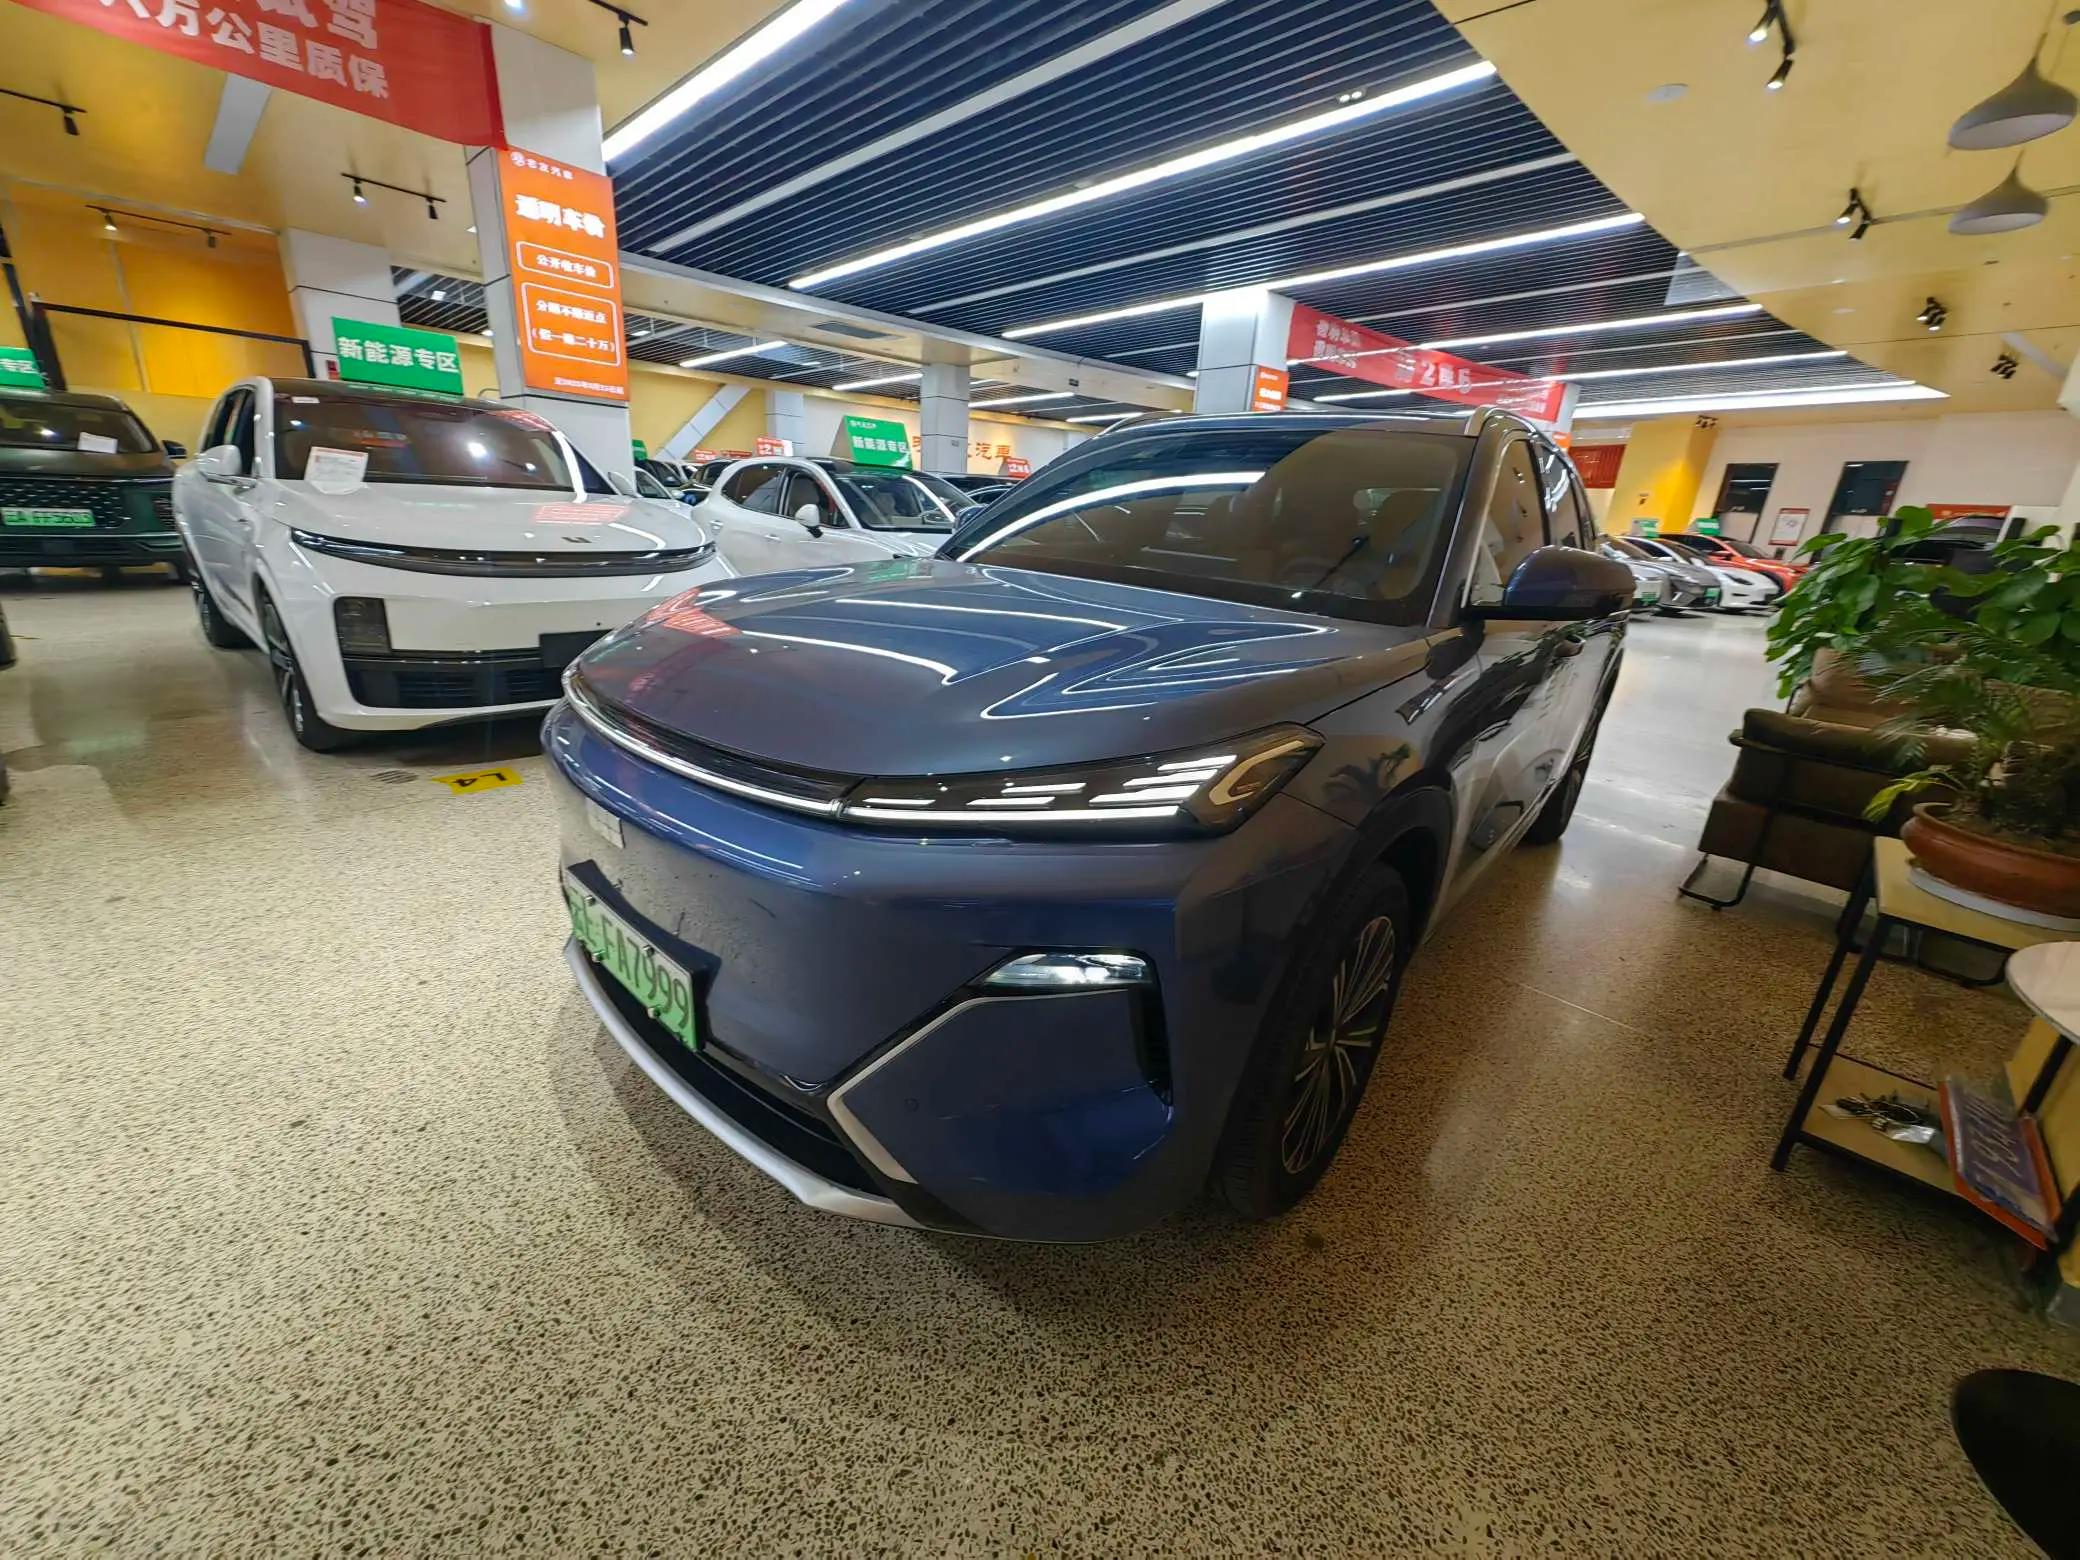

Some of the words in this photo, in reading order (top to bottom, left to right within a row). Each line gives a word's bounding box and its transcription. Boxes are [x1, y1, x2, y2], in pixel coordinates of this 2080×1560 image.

[338, 336, 460, 373] 新能源专区
